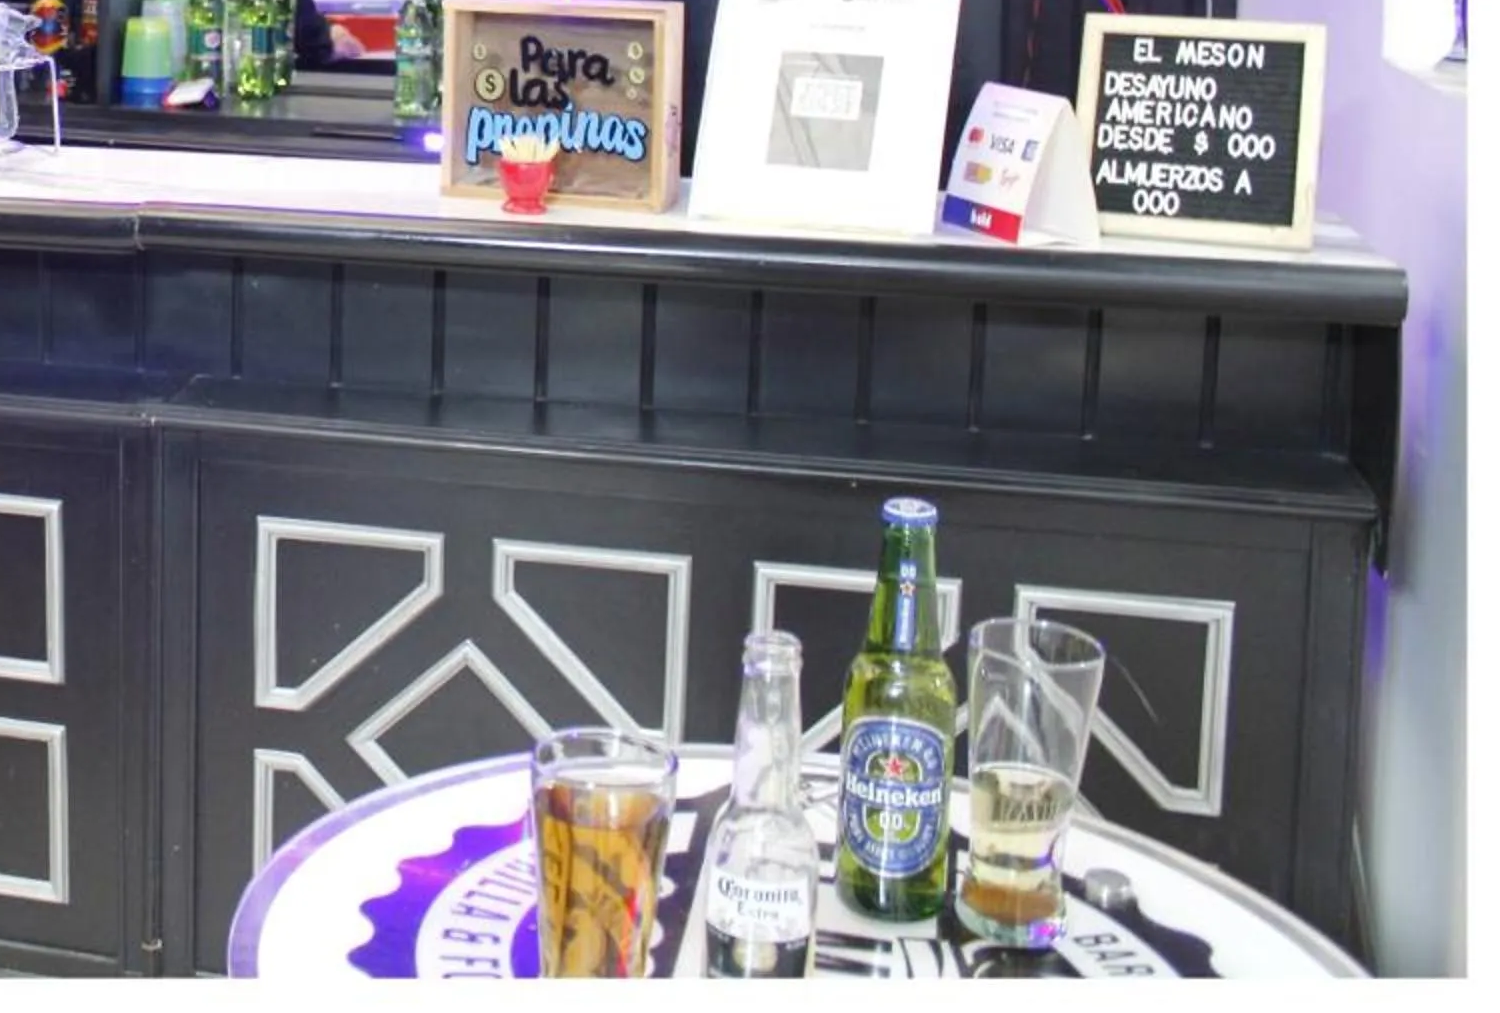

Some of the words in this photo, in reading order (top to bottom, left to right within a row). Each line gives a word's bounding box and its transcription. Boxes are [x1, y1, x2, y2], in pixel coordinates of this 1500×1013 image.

[520, 34, 615, 86] Para
[1132, 37, 1163, 64] EL
[1175, 40, 1266, 70] MESON
[509, 68, 570, 109] las
[1104, 70, 1217, 102] DESAYUNO
[1106, 97, 1253, 131] AMERICANO
[466, 101, 650, 165] propinas
[1097, 123, 1175, 155] DESDE
[1193, 130, 1209, 156] $
[1095, 159, 1224, 193] ALMUERZOS
[1234, 168, 1253, 195] A
[845, 771, 943, 808] Heineken
[717, 876, 802, 905] Coronita
